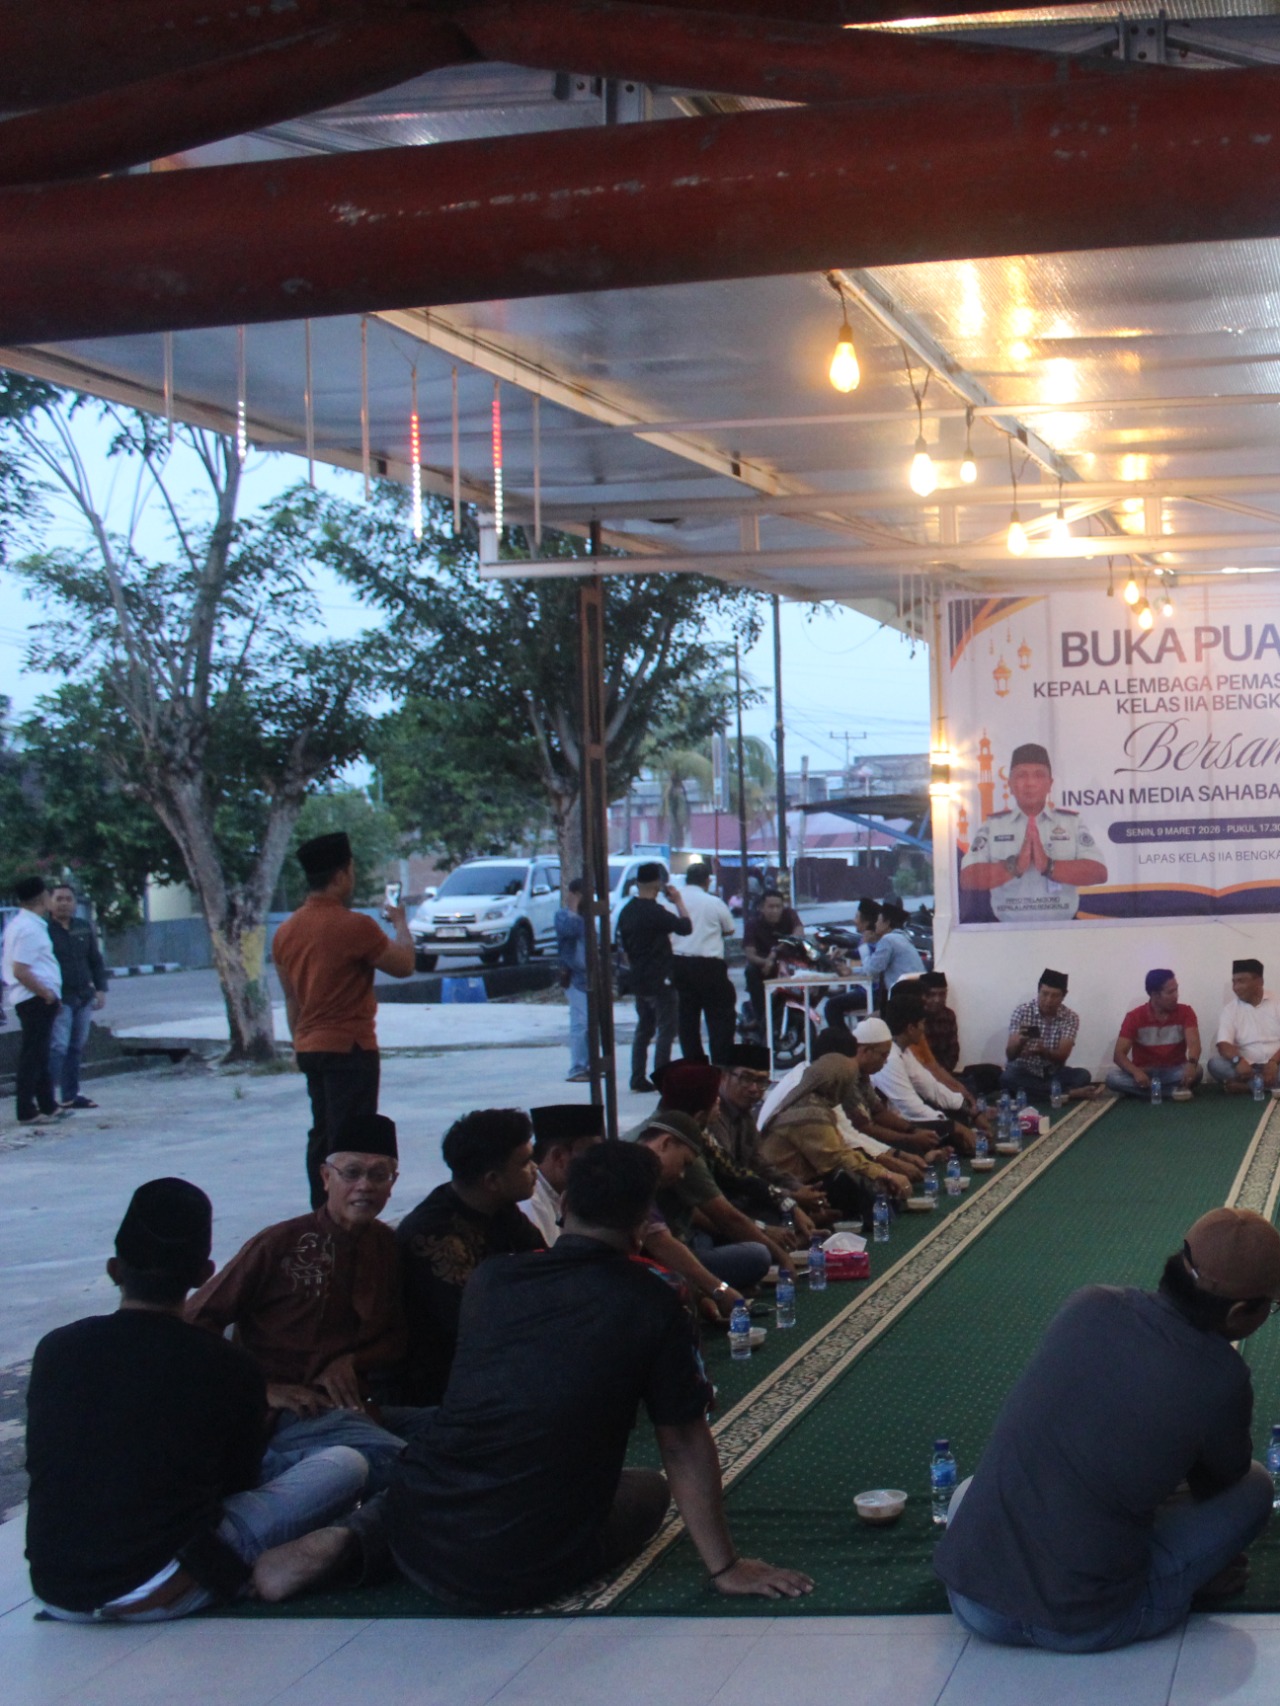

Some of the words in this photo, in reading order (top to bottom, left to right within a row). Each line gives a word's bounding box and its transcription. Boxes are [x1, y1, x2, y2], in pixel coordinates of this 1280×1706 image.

[1061, 628, 1186, 667] BUKA
[1033, 679, 1111, 698] KEPALA
[1114, 675, 1213, 695] LEMBAGA
[1116, 696, 1181, 715] KELAS
[1184, 695, 1209, 712] IIA
[1062, 788, 1125, 807] INSAN
[1129, 786, 1195, 805] MEDIA
[1156, 827, 1164, 836] 9
[1164, 825, 1197, 836] MARET
[1198, 825, 1221, 835] 2026
[1226, 824, 1257, 834] PUKUL
[1138, 853, 1176, 865] LAPAS
[1178, 851, 1216, 864] KELAS
[1217, 851, 1234, 862] IIA
